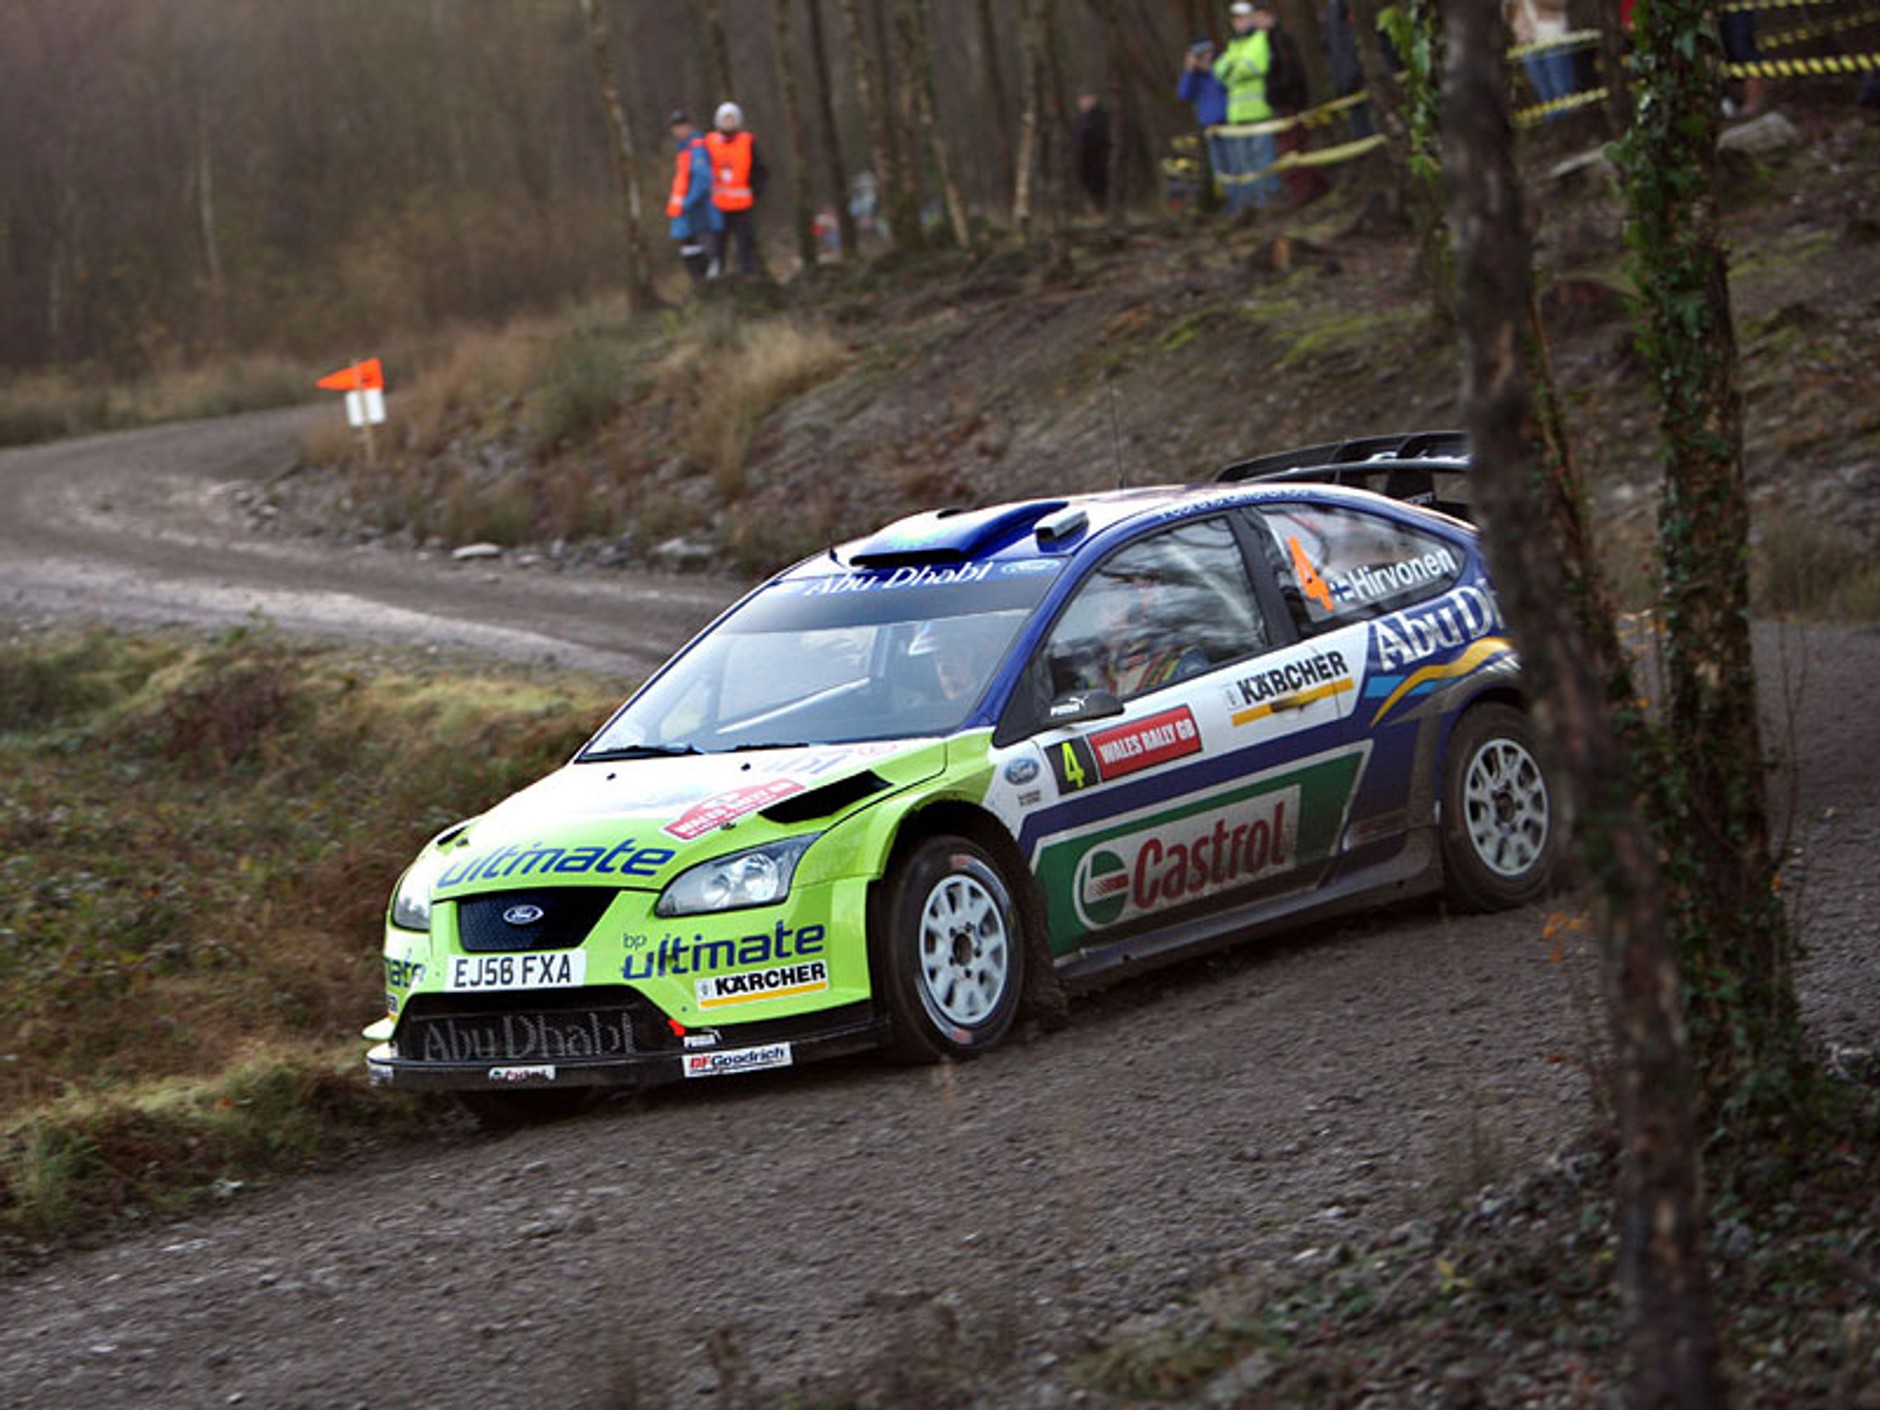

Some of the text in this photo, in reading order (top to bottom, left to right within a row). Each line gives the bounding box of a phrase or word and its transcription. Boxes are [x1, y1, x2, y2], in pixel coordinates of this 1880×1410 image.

[804, 571, 879, 597] Abu
[1288, 535, 1335, 613] 4
[1348, 547, 1456, 600] Hirvonen
[1236, 650, 1349, 704] KÄRCHER
[1061, 742, 1084, 789] 4
[1099, 733, 1143, 765] WALES
[1141, 723, 1176, 752] RALLY
[436, 838, 676, 888] ultimate
[1133, 801, 1287, 909] Castrol
[621, 920, 825, 980] ultimate
[623, 934, 647, 950] bp
[454, 954, 571, 989] EJ58 FXA
[715, 962, 826, 996] KÄRCHER
